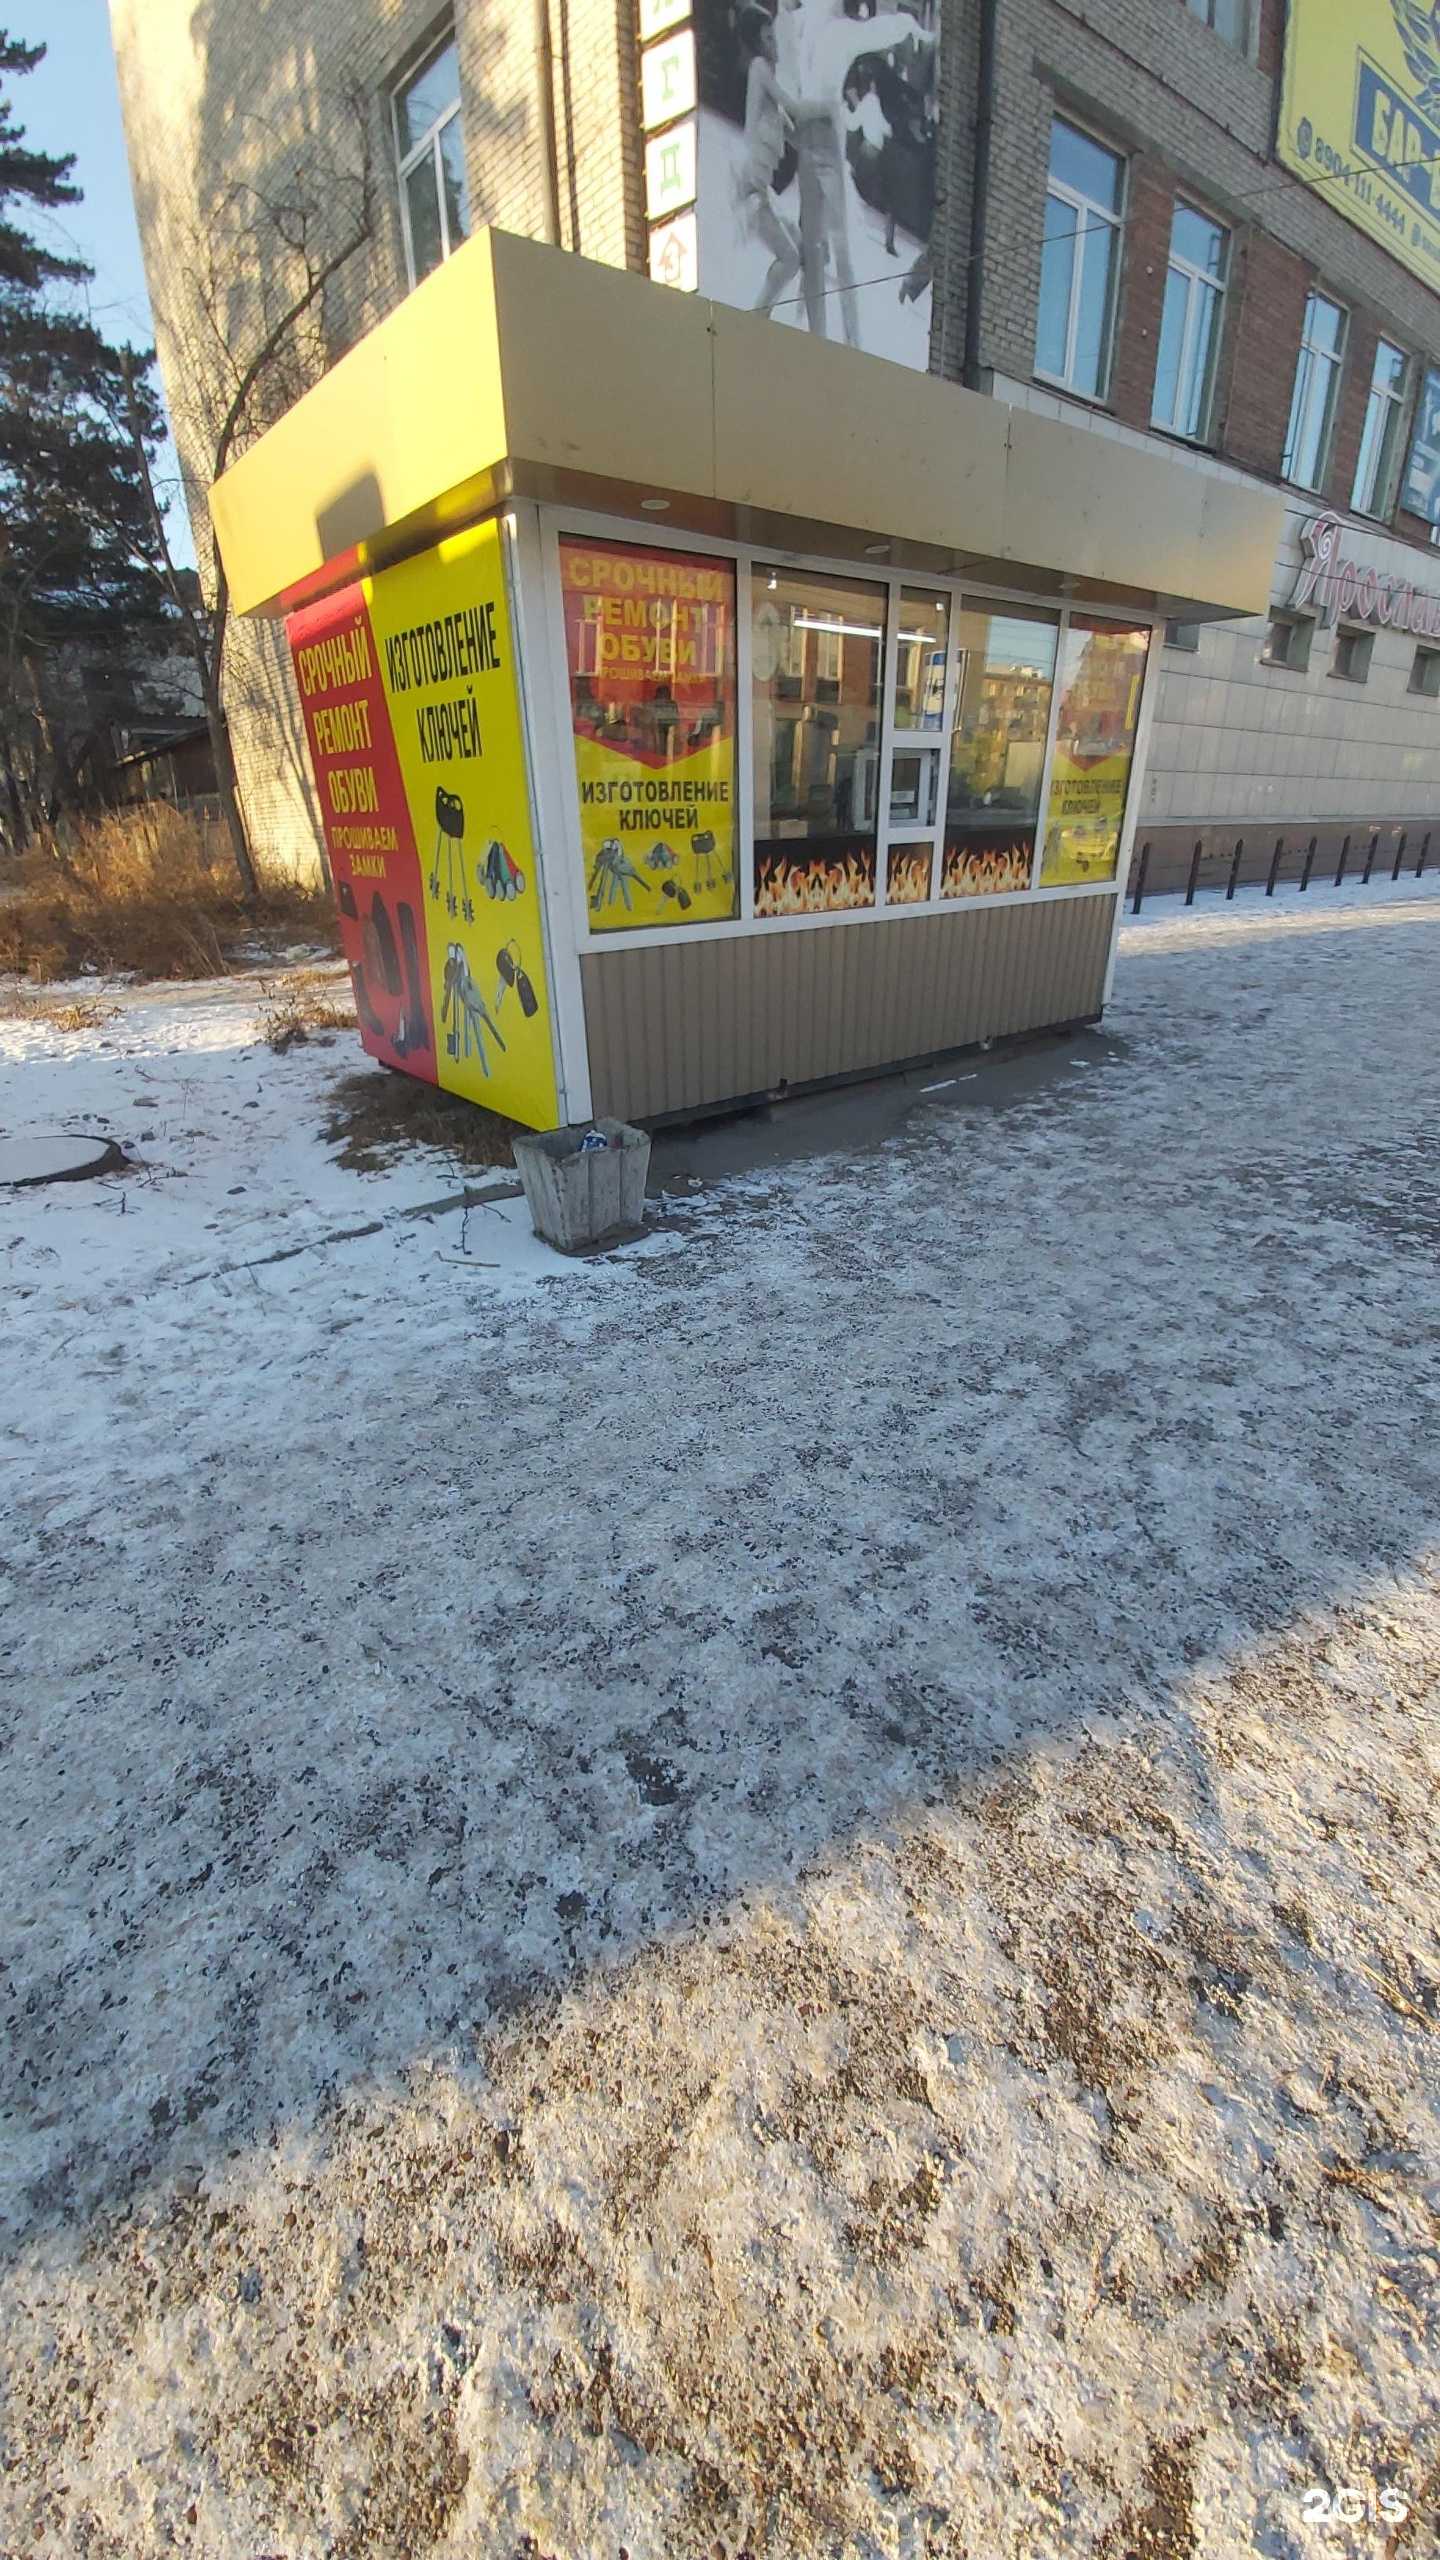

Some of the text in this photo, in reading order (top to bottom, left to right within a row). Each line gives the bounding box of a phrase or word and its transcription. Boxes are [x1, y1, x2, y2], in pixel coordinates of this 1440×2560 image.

[583, 595, 706, 633] РЕМОНТ
[299, 615, 372, 697] СРОЧНЫЙ
[384, 602, 501, 694] ИЗГОТОВЛЕНИЕ
[600, 632, 697, 666] ОБУВИ
[312, 700, 373, 756] РЕМОНТ
[416, 685, 483, 763] КЛЮЧЕЙ
[328, 767, 379, 814] ОБУВИ
[581, 780, 729, 804] ИЗГОТОВЛЕНИЕ
[619, 804, 699, 831] КЛЮЧЕЙ
[331, 826, 400, 852] ПРОШИВАЕМ
[350, 855, 387, 879] ЗАМКИ
